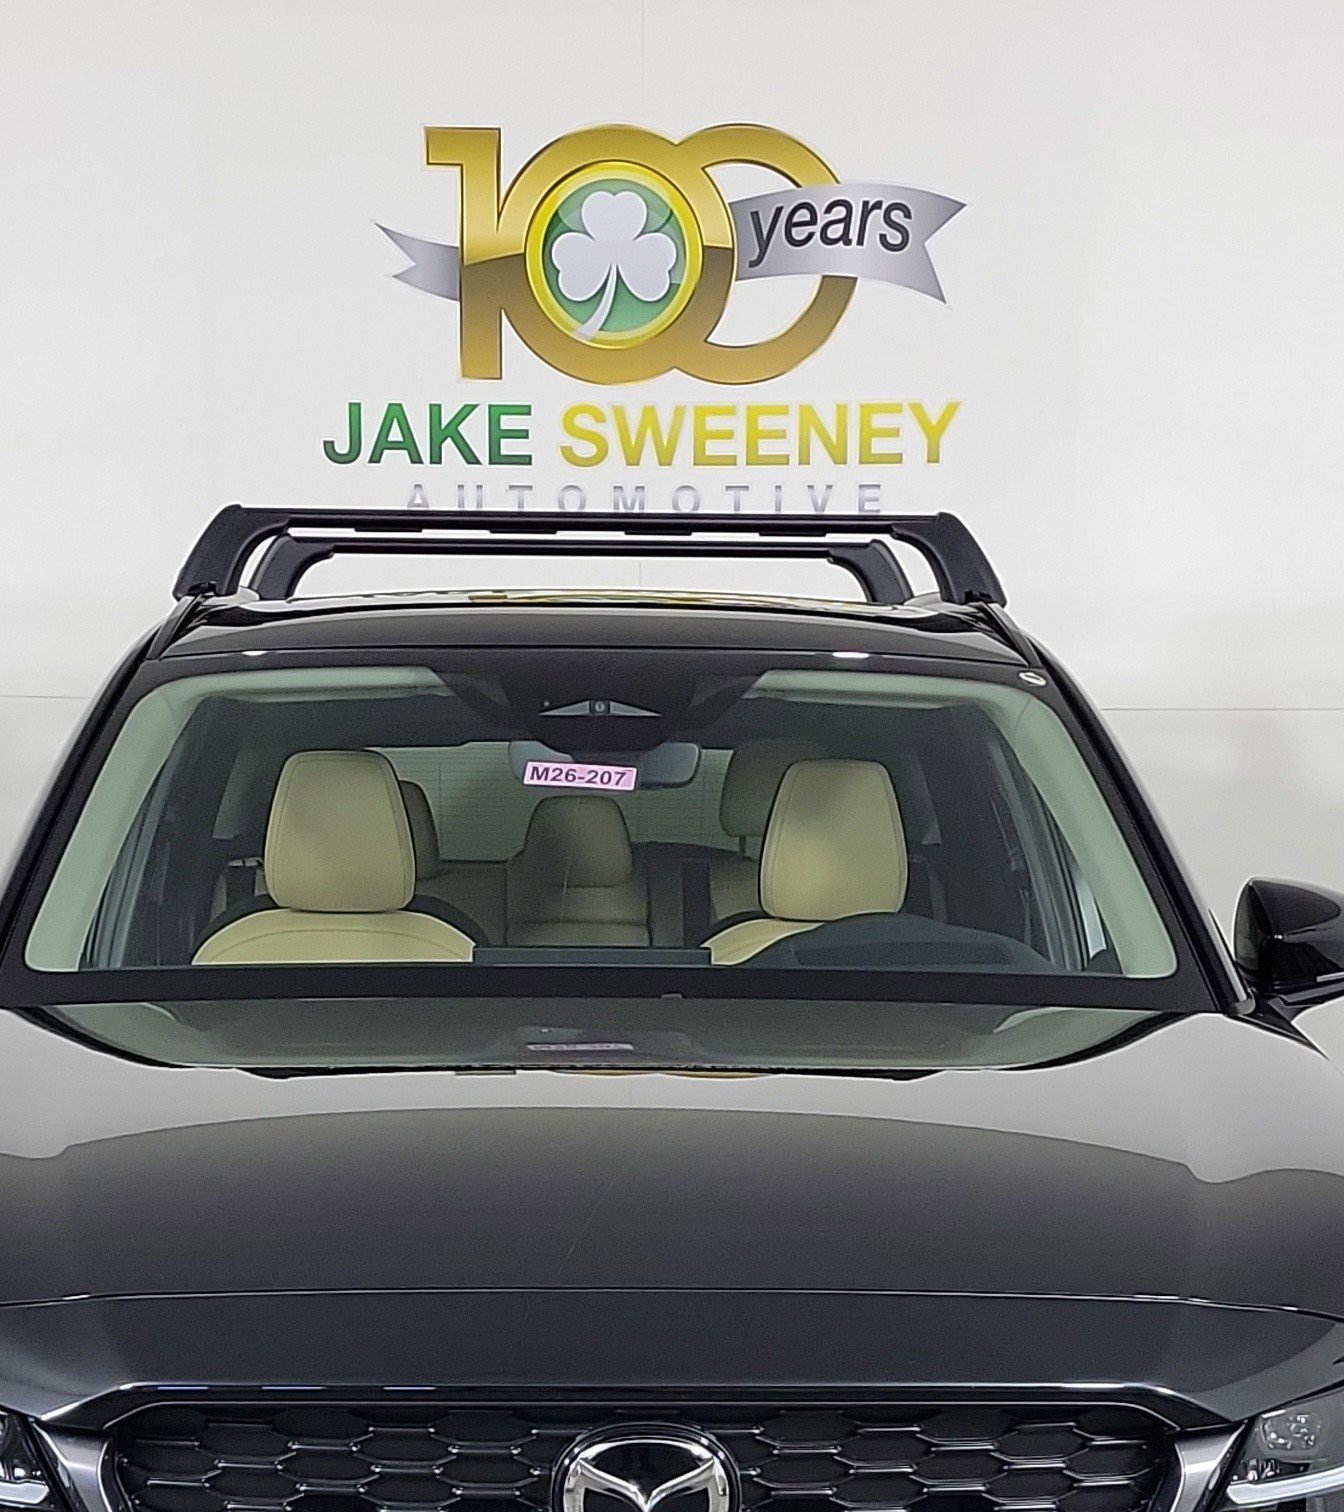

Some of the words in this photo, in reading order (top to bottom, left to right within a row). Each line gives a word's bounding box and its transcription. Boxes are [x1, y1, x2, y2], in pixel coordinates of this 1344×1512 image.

[423, 122, 861, 386] 100
[747, 198, 914, 269] years
[322, 402, 533, 466] JAKE
[558, 401, 962, 467] SWEENEY
[406, 483, 882, 514] AUTOMOTIVE
[529, 765, 627, 787] M26-207
